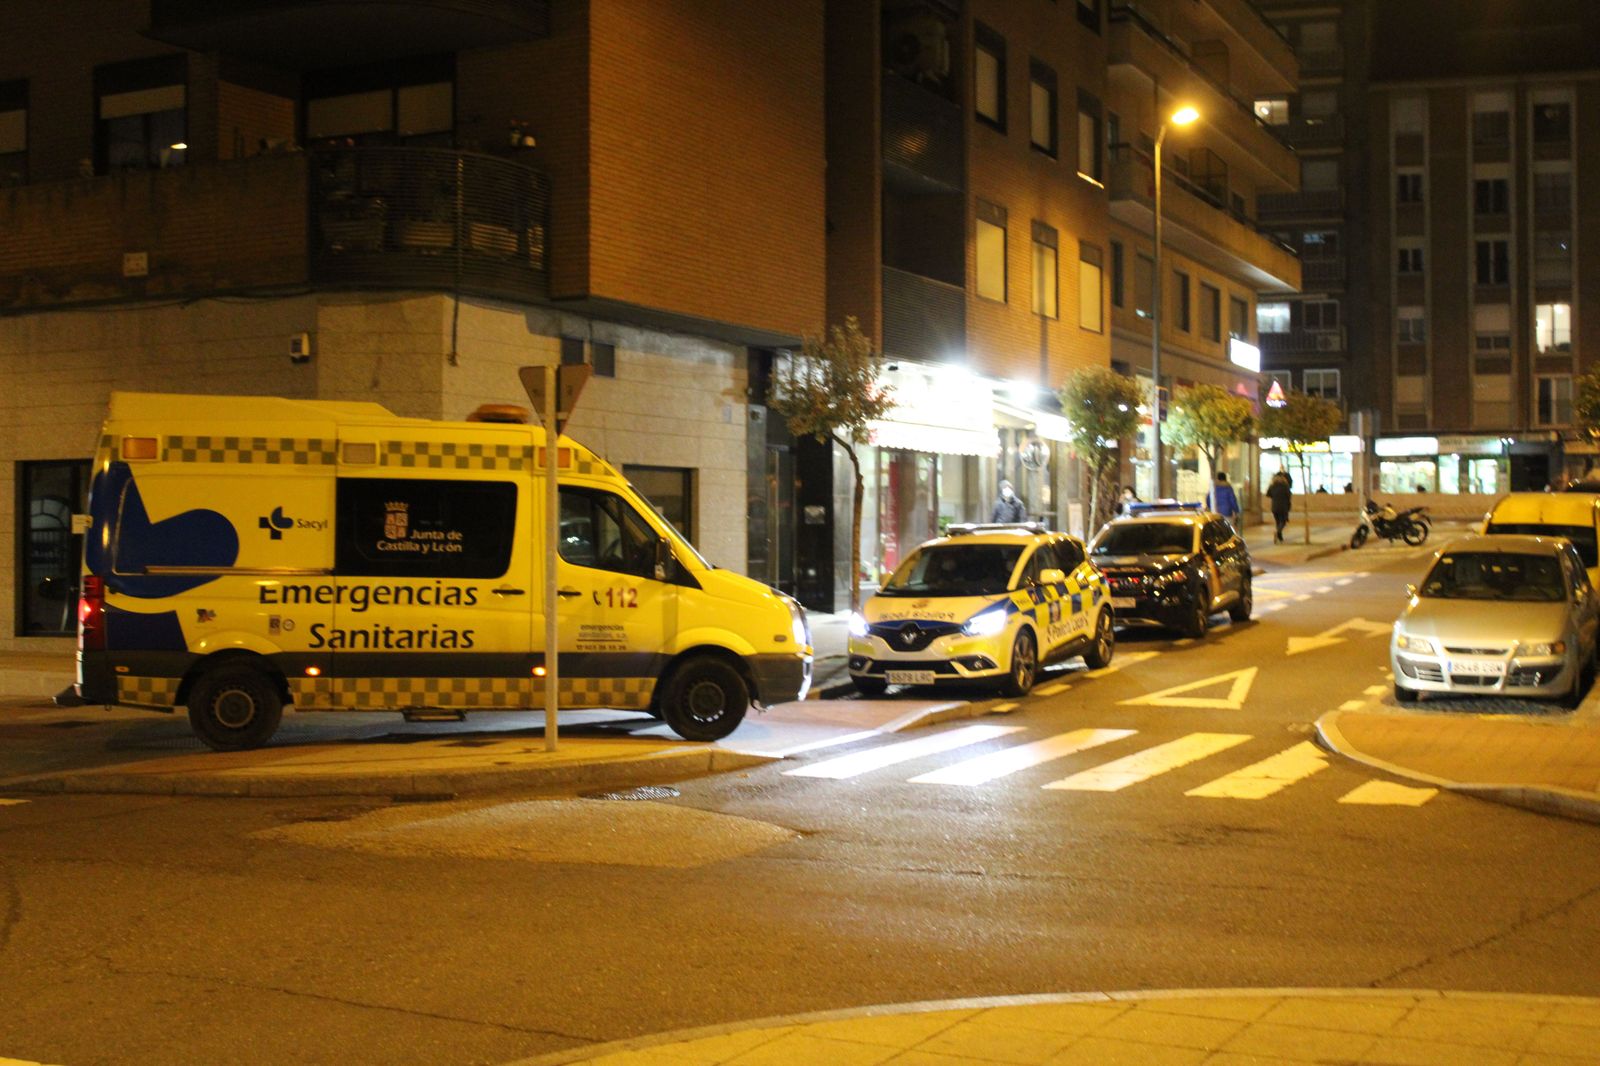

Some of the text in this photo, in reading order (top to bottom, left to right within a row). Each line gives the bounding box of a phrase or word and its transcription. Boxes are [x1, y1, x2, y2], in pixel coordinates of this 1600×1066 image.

[297, 518, 328, 531] Sacyl
[410, 529, 463, 540] Junta de
[376, 541, 462, 554] Castilla y León
[258, 581, 478, 612] Emergencias
[605, 587, 638, 608] 112
[308, 623, 475, 649] Sanitarias
